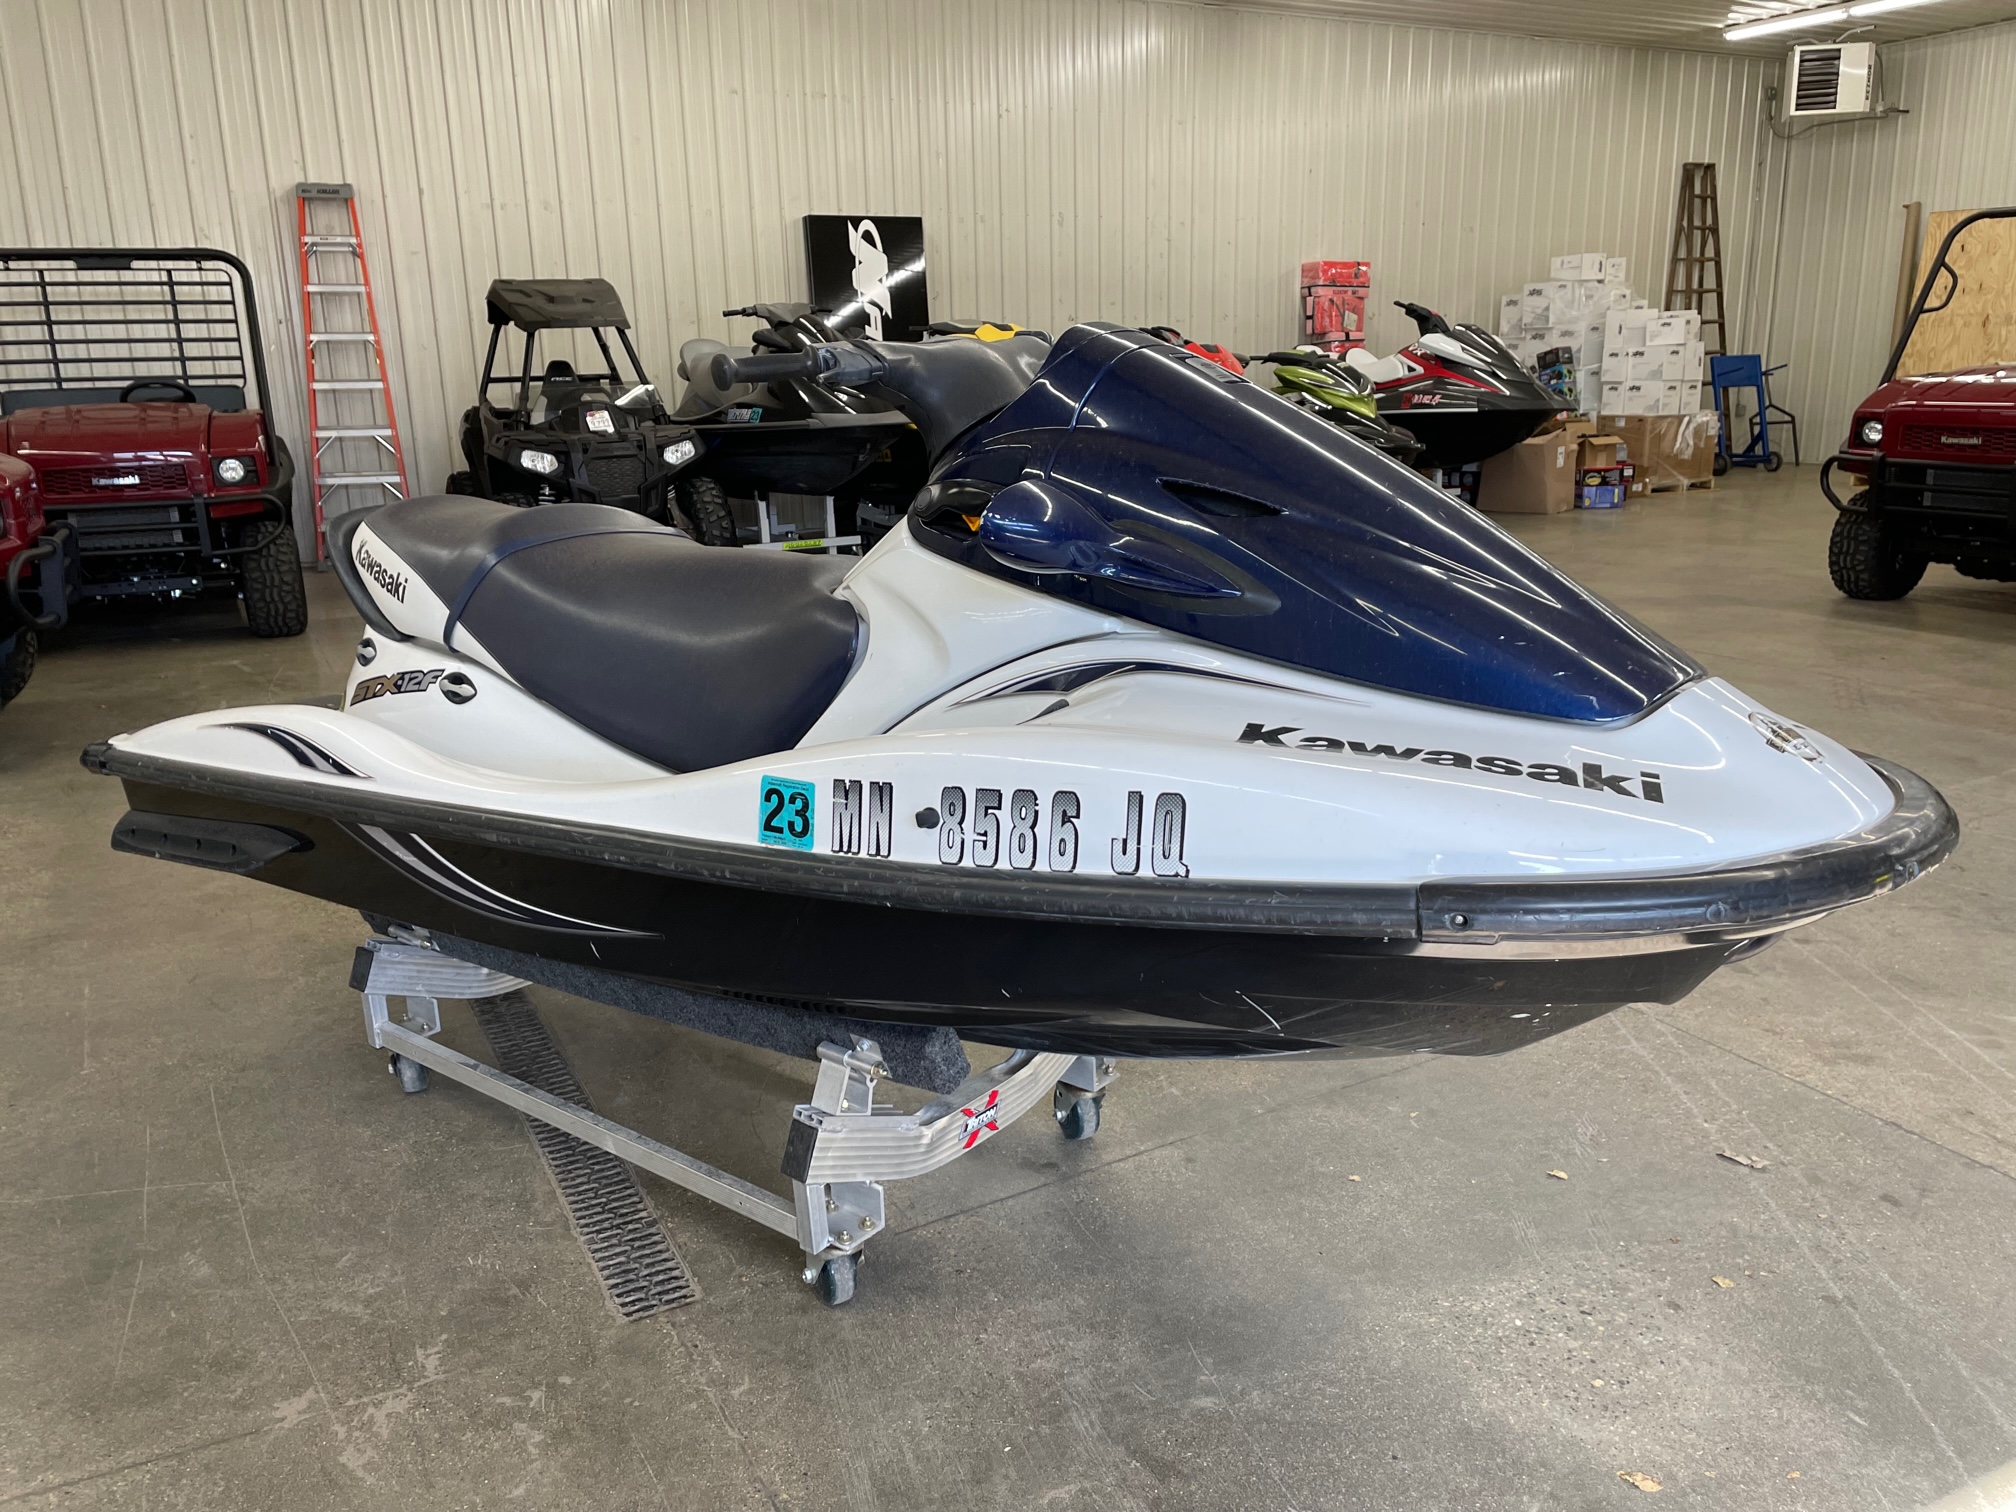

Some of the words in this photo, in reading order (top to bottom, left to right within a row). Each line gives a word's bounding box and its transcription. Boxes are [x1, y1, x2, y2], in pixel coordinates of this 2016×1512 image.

[982, 435, 1941, 445] Kawasaki
[91, 474, 140, 486] Kawasaki
[355, 538, 408, 604] Kawasaki
[1236, 722, 1664, 804] Kawasaki
[763, 787, 810, 839] 23
[831, 779, 893, 858] MN
[939, 786, 1081, 873] 8586
[1111, 791, 1190, 878] JQ
